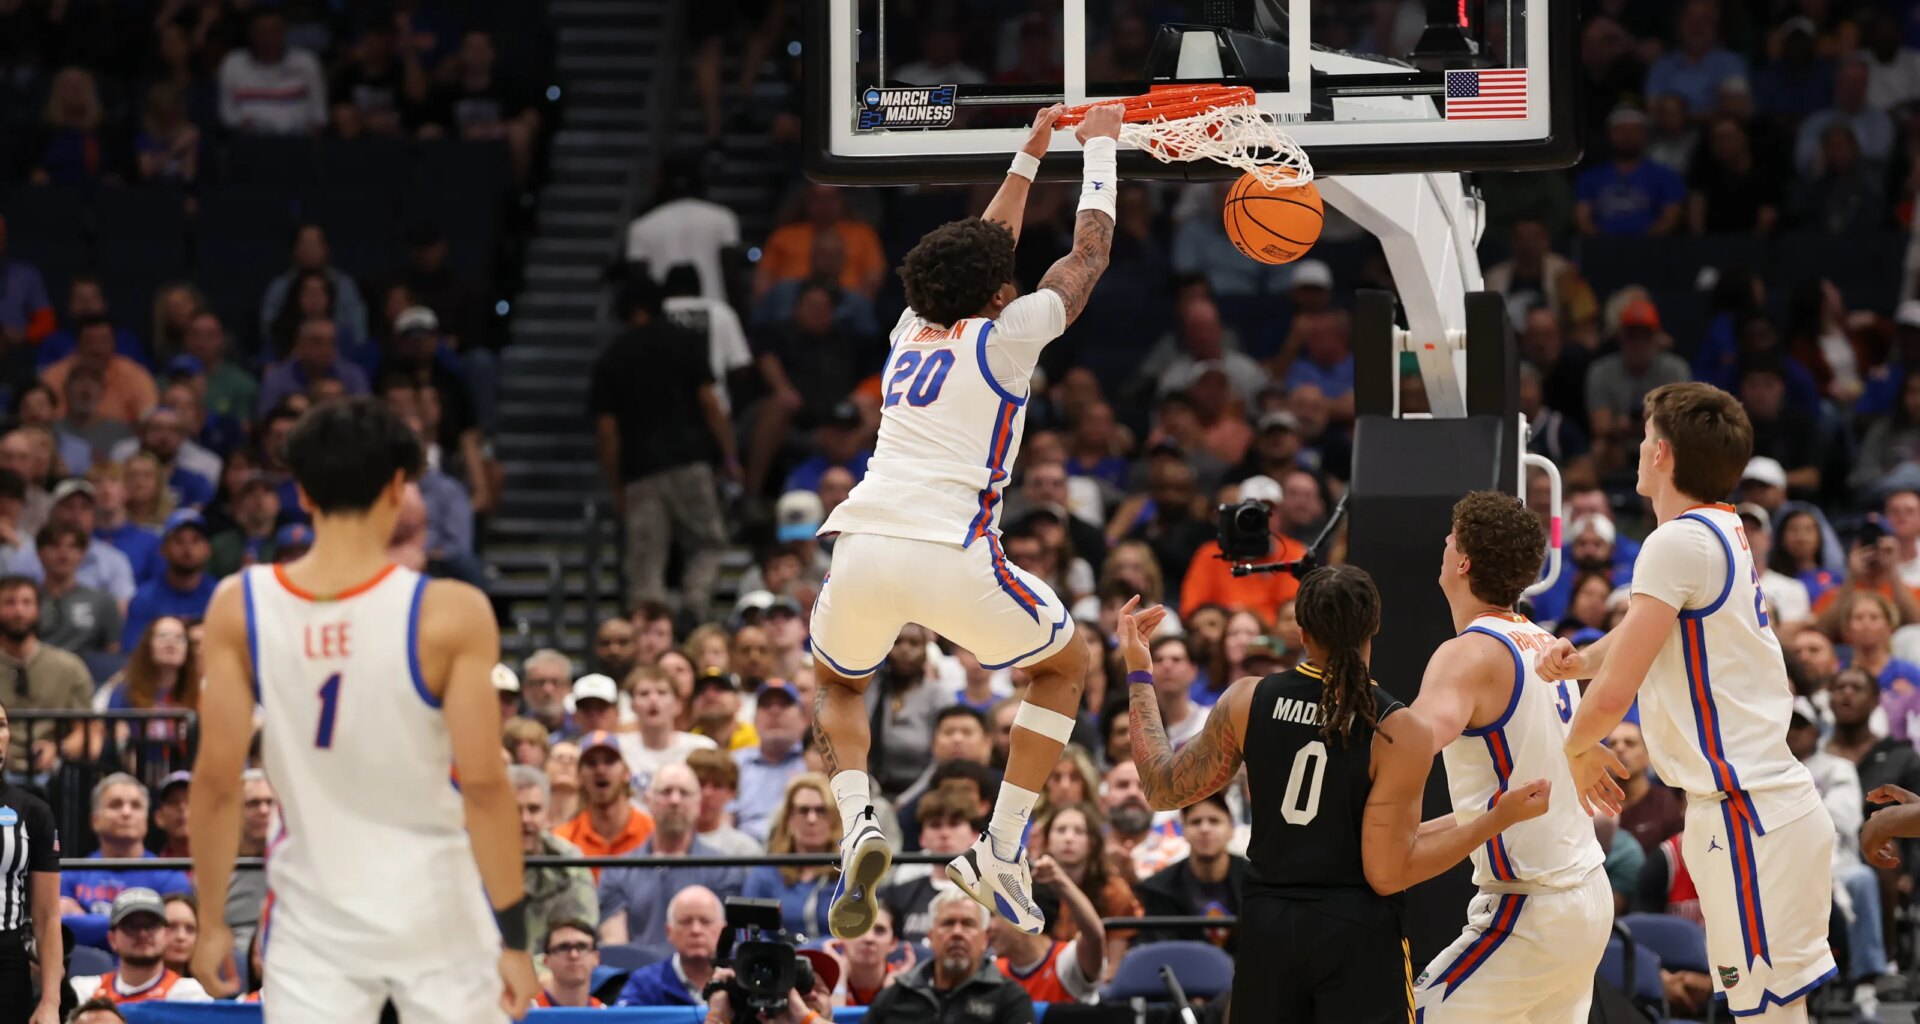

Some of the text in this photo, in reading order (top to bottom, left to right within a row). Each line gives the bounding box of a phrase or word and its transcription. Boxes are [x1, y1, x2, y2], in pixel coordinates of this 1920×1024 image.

[880, 90, 930, 106] MARCH
[885, 105, 953, 121] MADNESS
[884, 349, 956, 409] 20
[304, 622, 352, 658] LEE
[315, 671, 342, 748] 1
[1280, 740, 1328, 826] 0
